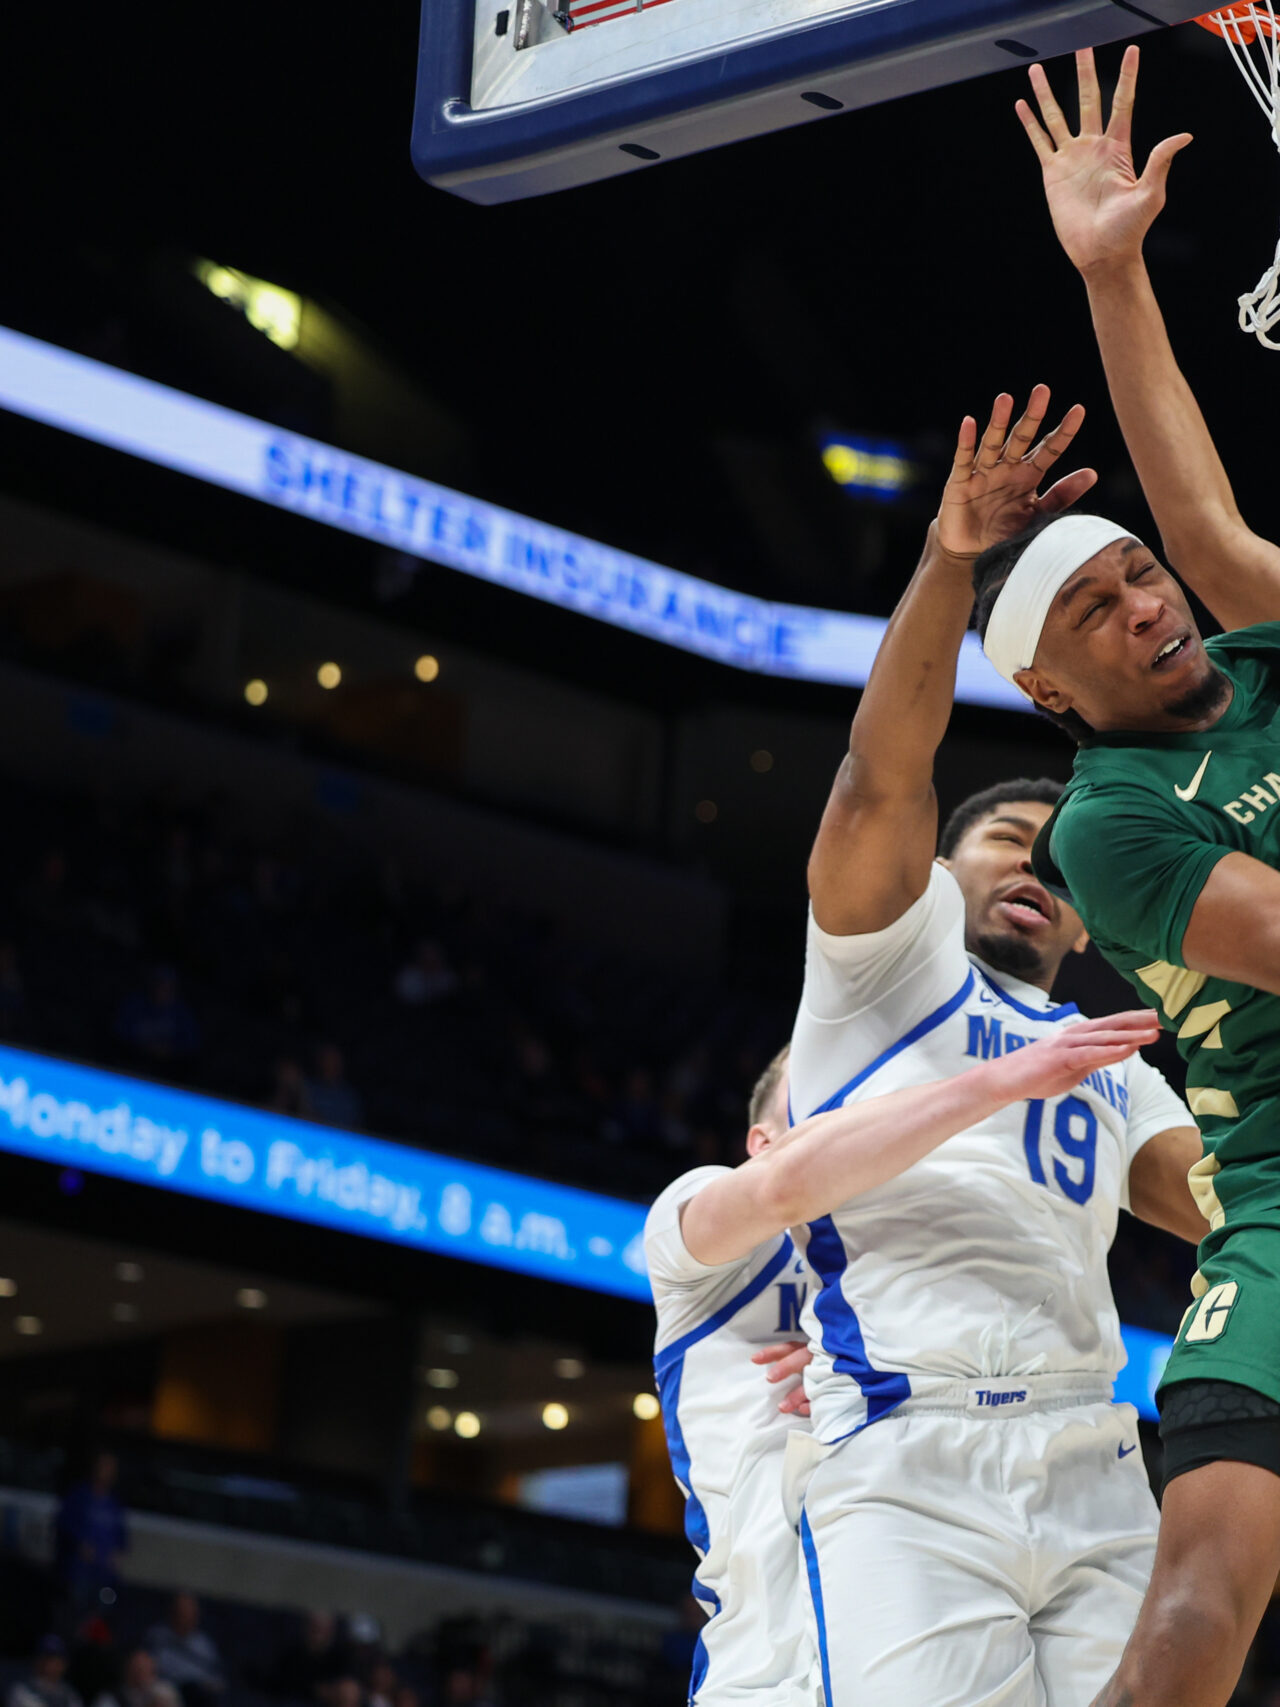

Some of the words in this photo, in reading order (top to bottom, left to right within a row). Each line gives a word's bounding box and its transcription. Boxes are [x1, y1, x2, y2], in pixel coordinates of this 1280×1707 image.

[263, 443, 487, 554] SHELTER
[506, 532, 800, 659] INSURANCE
[201, 1128, 255, 1184] to
[266, 1140, 427, 1232] Friday,
[439, 1183, 473, 1236] 8
[480, 1202, 576, 1261] a.m.
[1023, 1095, 1097, 1206] 19
[975, 1390, 1027, 1407] Tigers
